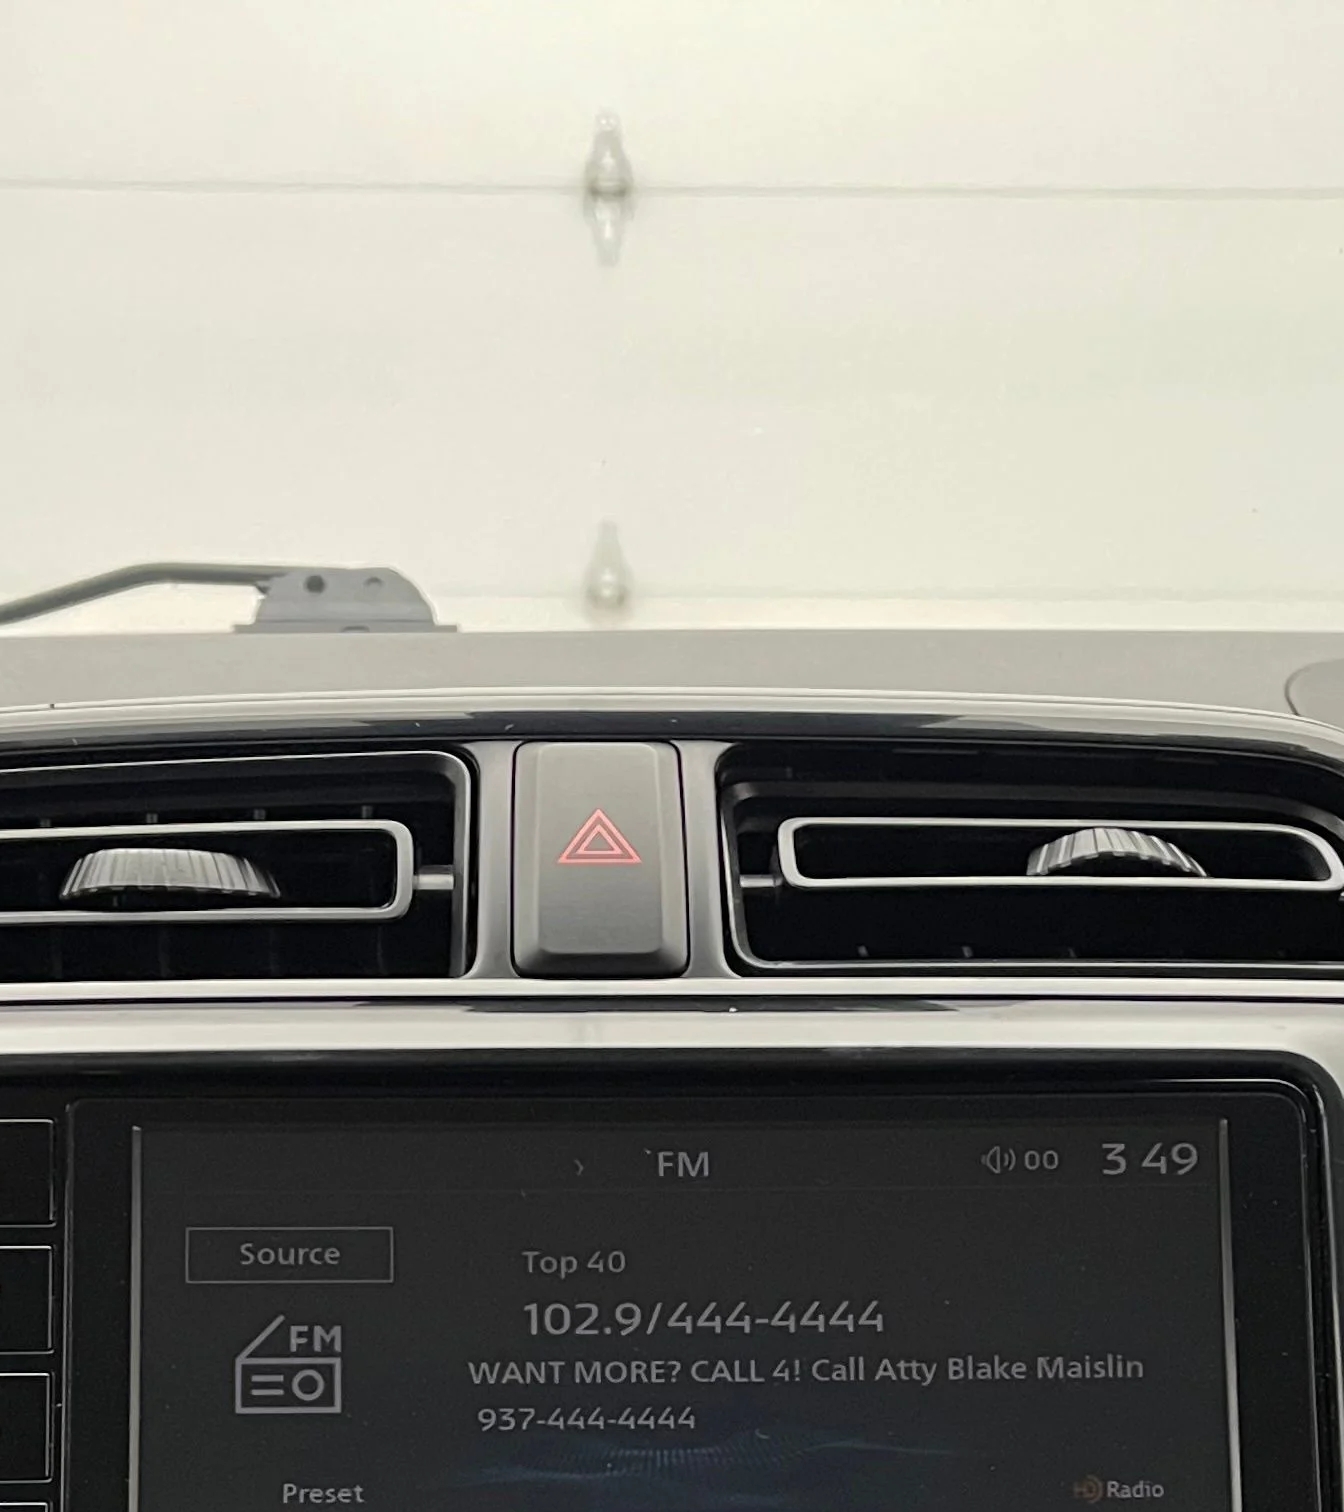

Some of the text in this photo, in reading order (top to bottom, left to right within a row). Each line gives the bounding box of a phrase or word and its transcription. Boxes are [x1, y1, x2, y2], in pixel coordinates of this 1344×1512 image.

[657, 1150, 710, 1177] FM
[1024, 1150, 1059, 1171] 00
[239, 1243, 341, 1266] Source
[523, 1251, 626, 1279] Top 40
[523, 1300, 885, 1337] 102.9/444-4444
[289, 1325, 342, 1353] FM
[468, 1354, 1145, 1386] WANT MORE? CALL 4! Call Atty Blake Maislin
[477, 1406, 696, 1432] 937-444-4444
[282, 1483, 365, 1504] Preset
[1106, 1480, 1165, 1499] Radio
